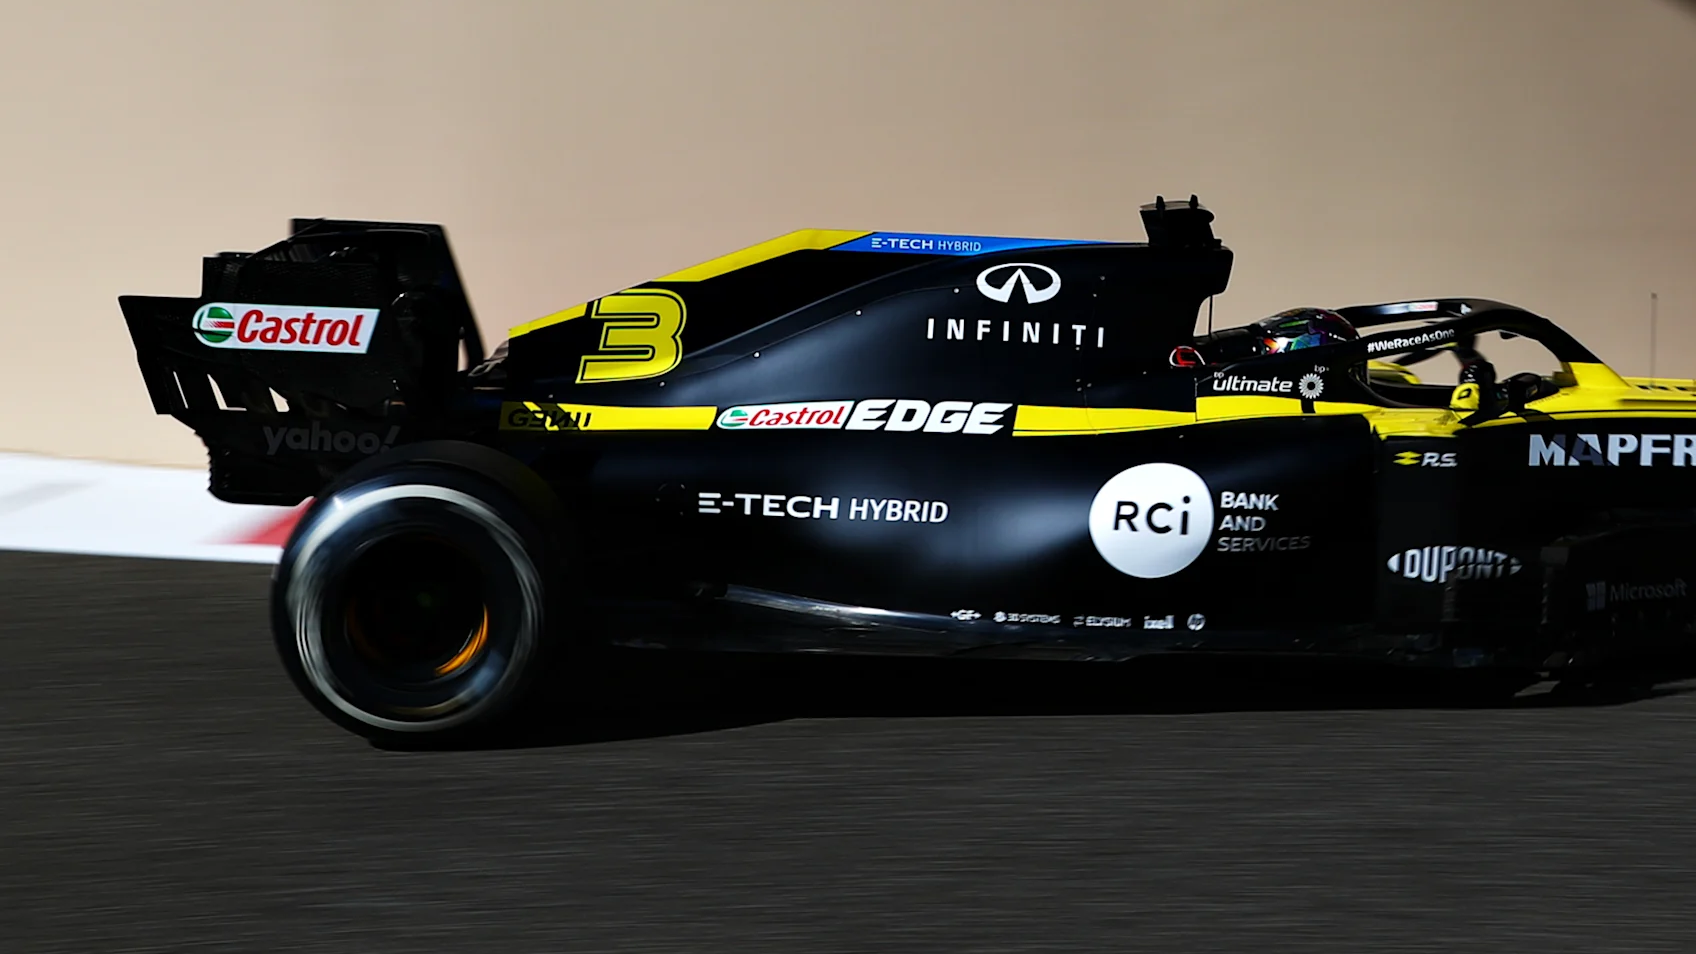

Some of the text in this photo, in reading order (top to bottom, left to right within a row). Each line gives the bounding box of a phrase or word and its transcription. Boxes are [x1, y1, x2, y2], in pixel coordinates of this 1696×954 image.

[871, 238, 981, 252] E-TECH HYBRID
[237, 309, 364, 346] Castrol
[574, 286, 688, 384] 3
[926, 317, 1104, 348] INFINITI
[1367, 328, 1455, 353] #WeRaceAsOne
[1212, 375, 1294, 393] ultimate
[749, 399, 1014, 435] Castrol EDGE
[262, 420, 401, 457] yahoo!
[697, 491, 950, 524] E-TECH HYBRID
[1220, 491, 1280, 511] BANK
[1218, 514, 1267, 532] AND
[1216, 535, 1313, 553] SERVICES
[1608, 577, 1689, 604] Microsoft
